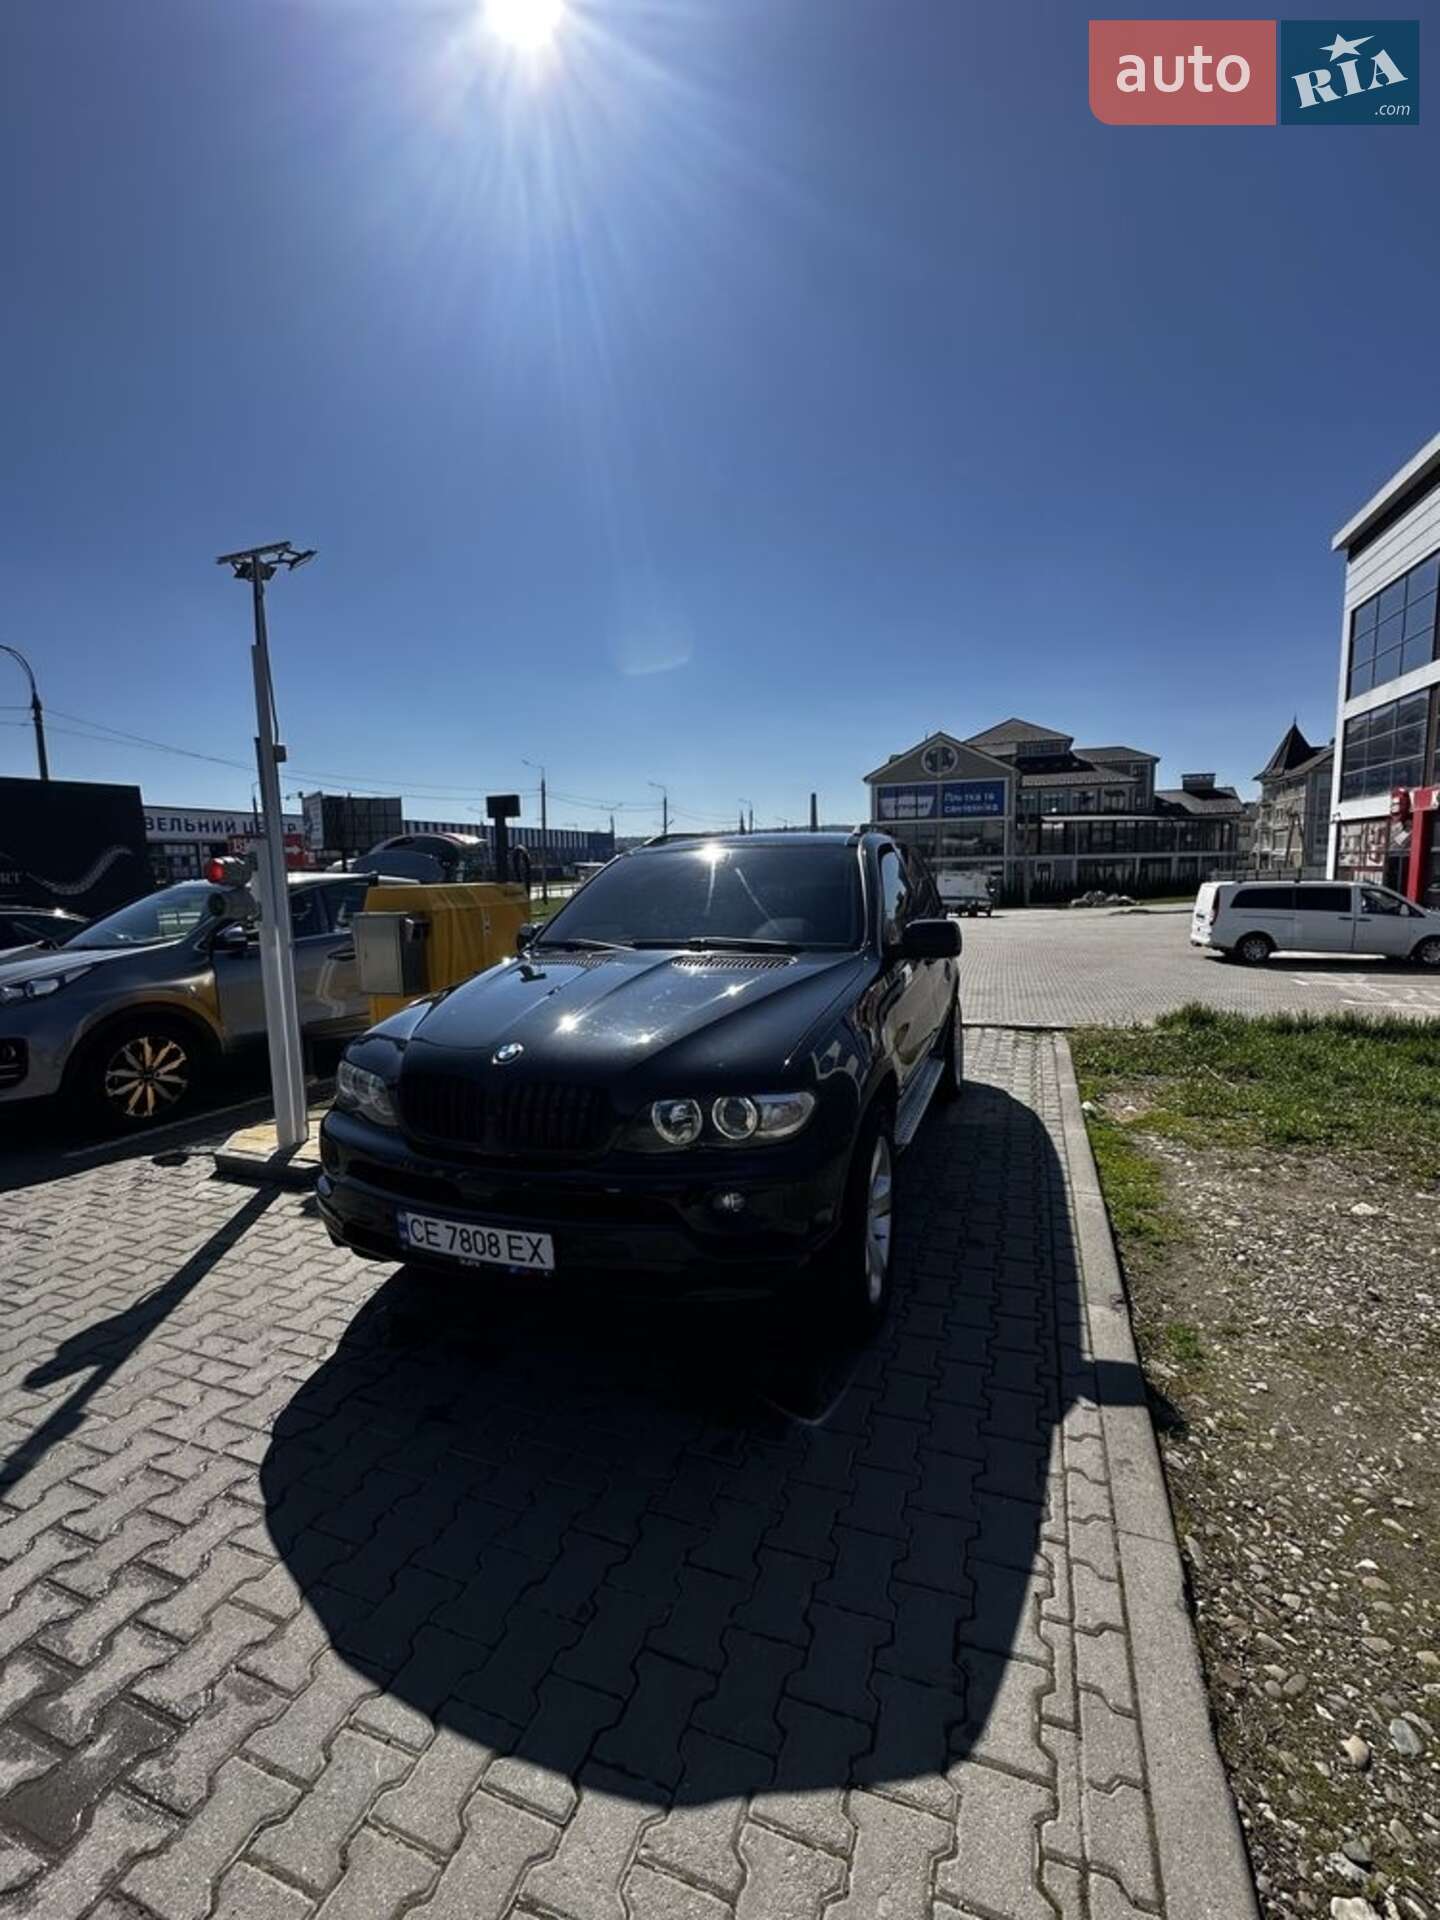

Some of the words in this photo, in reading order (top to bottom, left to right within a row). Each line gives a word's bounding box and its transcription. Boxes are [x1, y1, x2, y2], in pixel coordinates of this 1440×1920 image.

[410, 1218, 441, 1248] CE
[445, 1225, 501, 1258] 7808
[507, 1234, 546, 1264] EX
